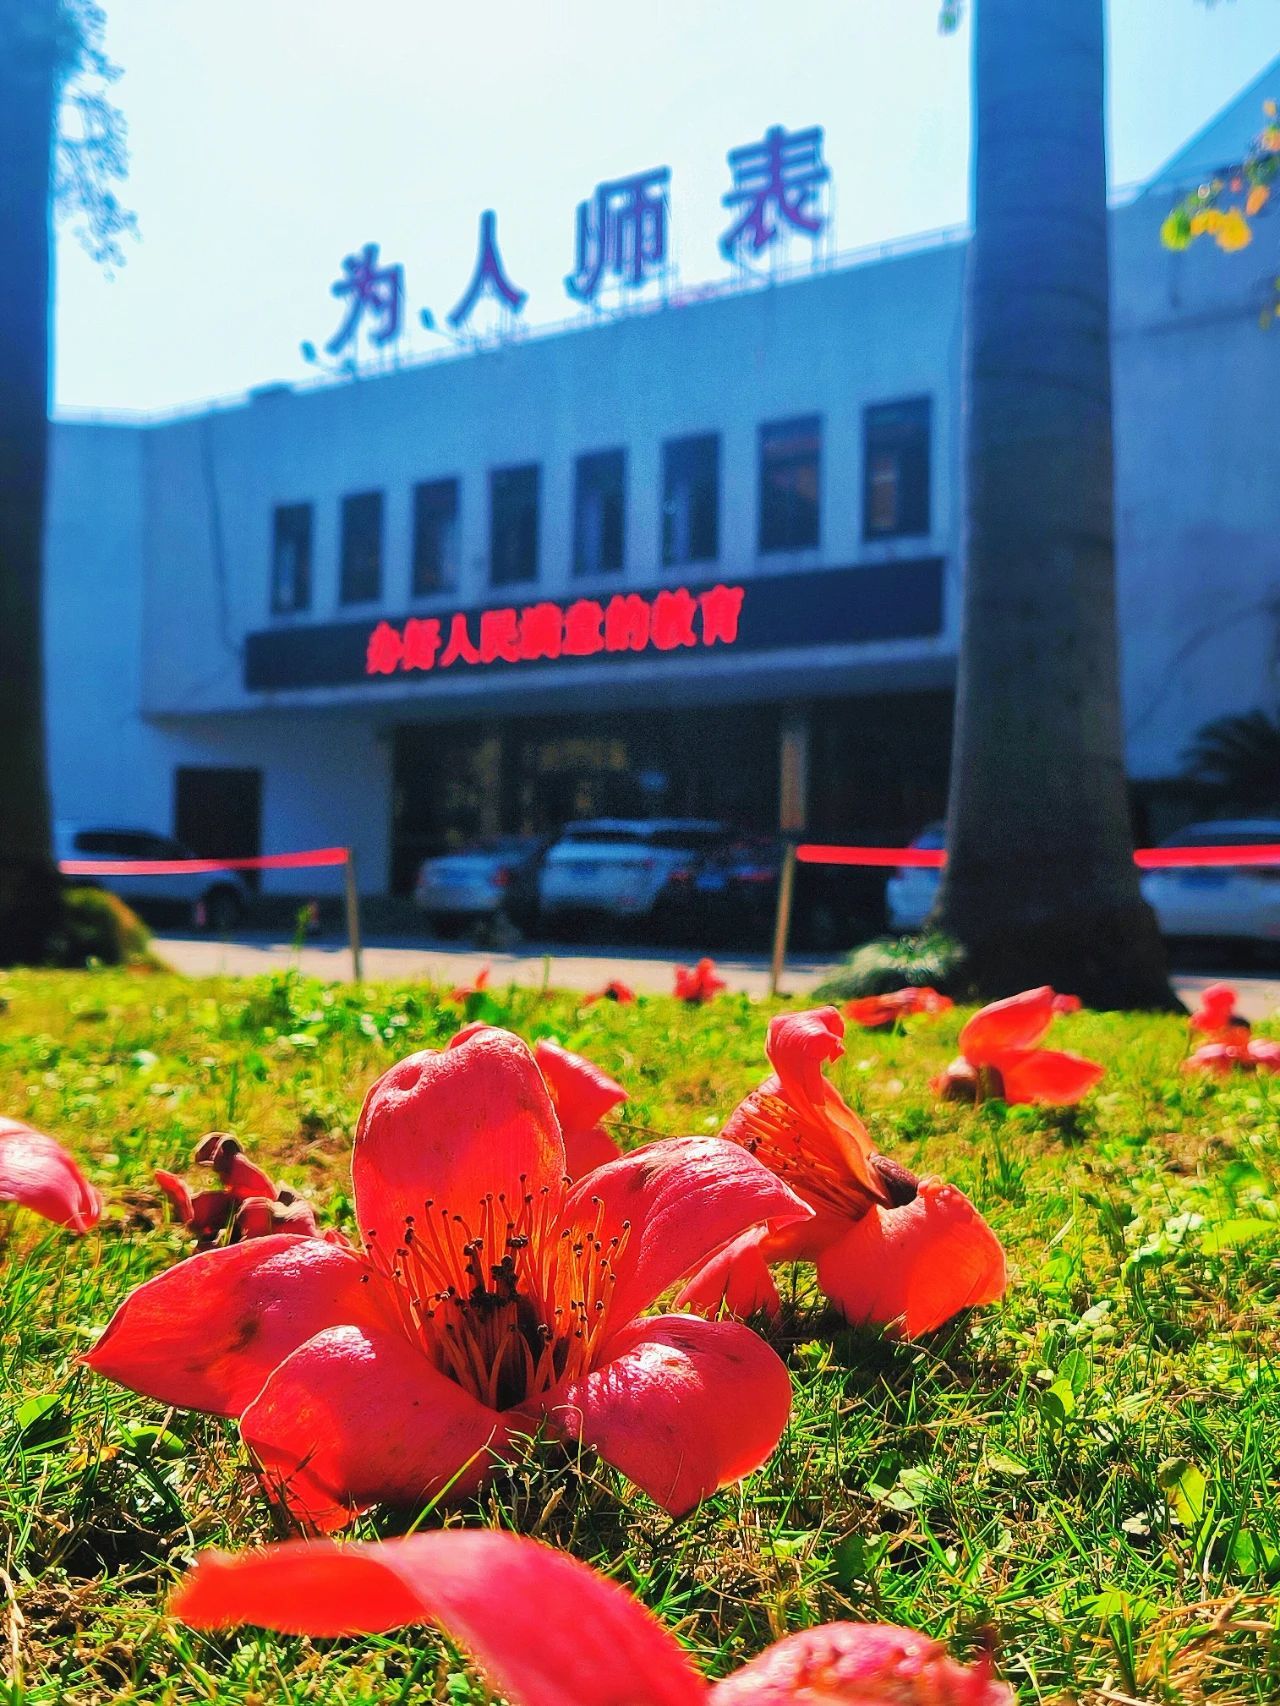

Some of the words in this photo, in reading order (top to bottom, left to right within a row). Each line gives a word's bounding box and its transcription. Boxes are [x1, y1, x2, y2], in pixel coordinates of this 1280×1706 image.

[324, 123, 831, 355] 为人师表
[366, 584, 745, 674] 办好人民满意的教育
